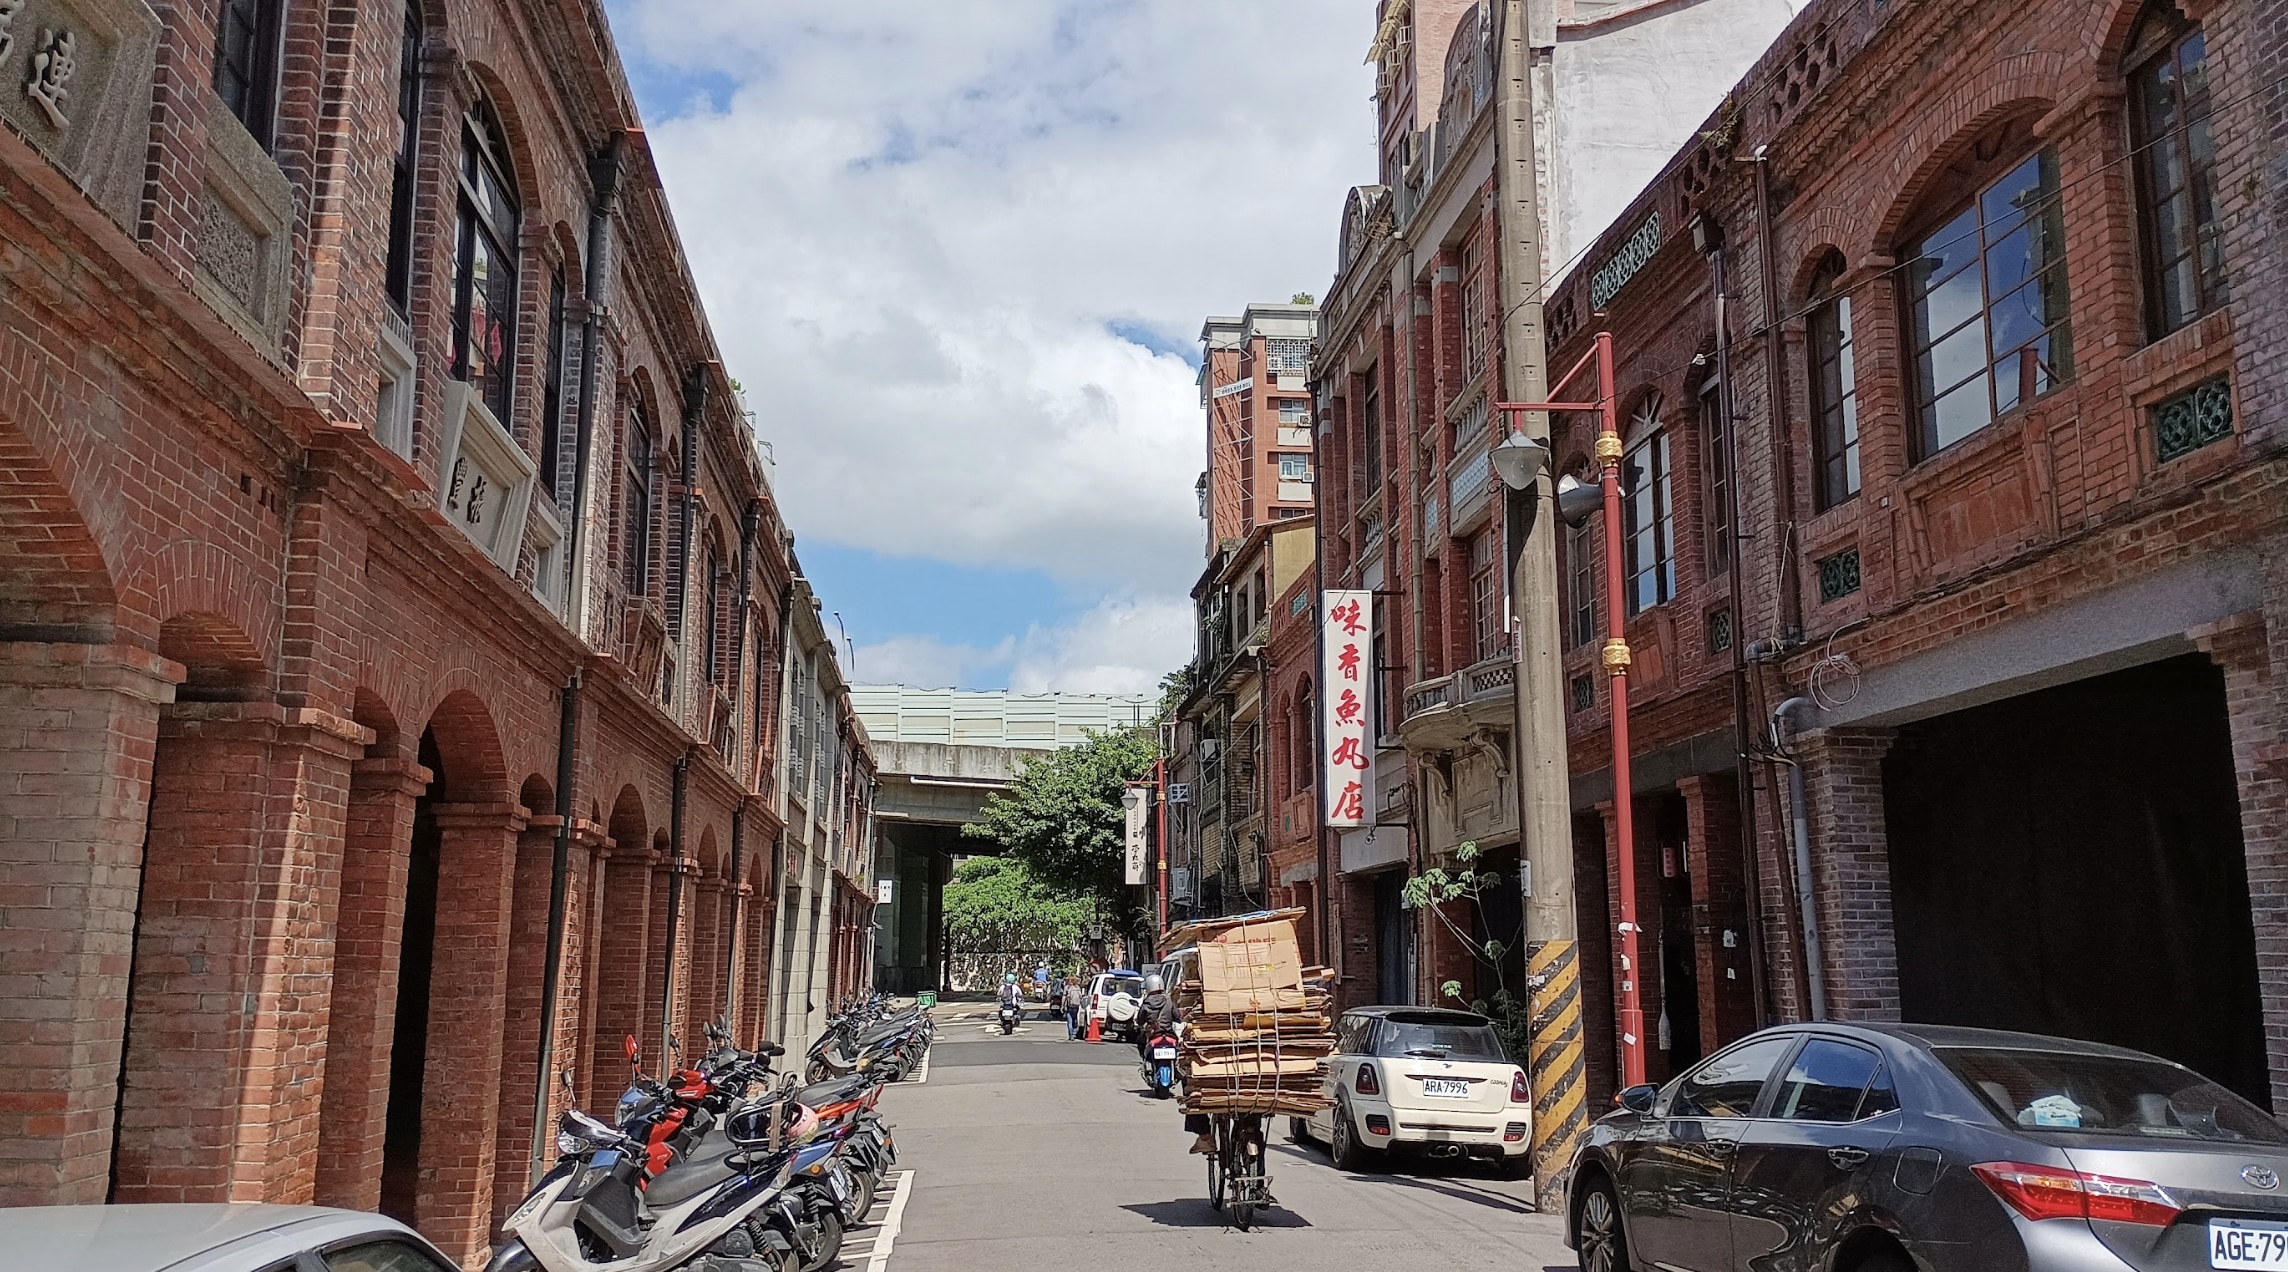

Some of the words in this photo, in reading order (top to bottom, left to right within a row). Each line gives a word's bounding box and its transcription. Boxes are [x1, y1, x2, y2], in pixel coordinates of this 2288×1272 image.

[1331, 598, 1370, 820] 味香魚丸店
[2214, 1230, 2288, 1262] AGE·79
